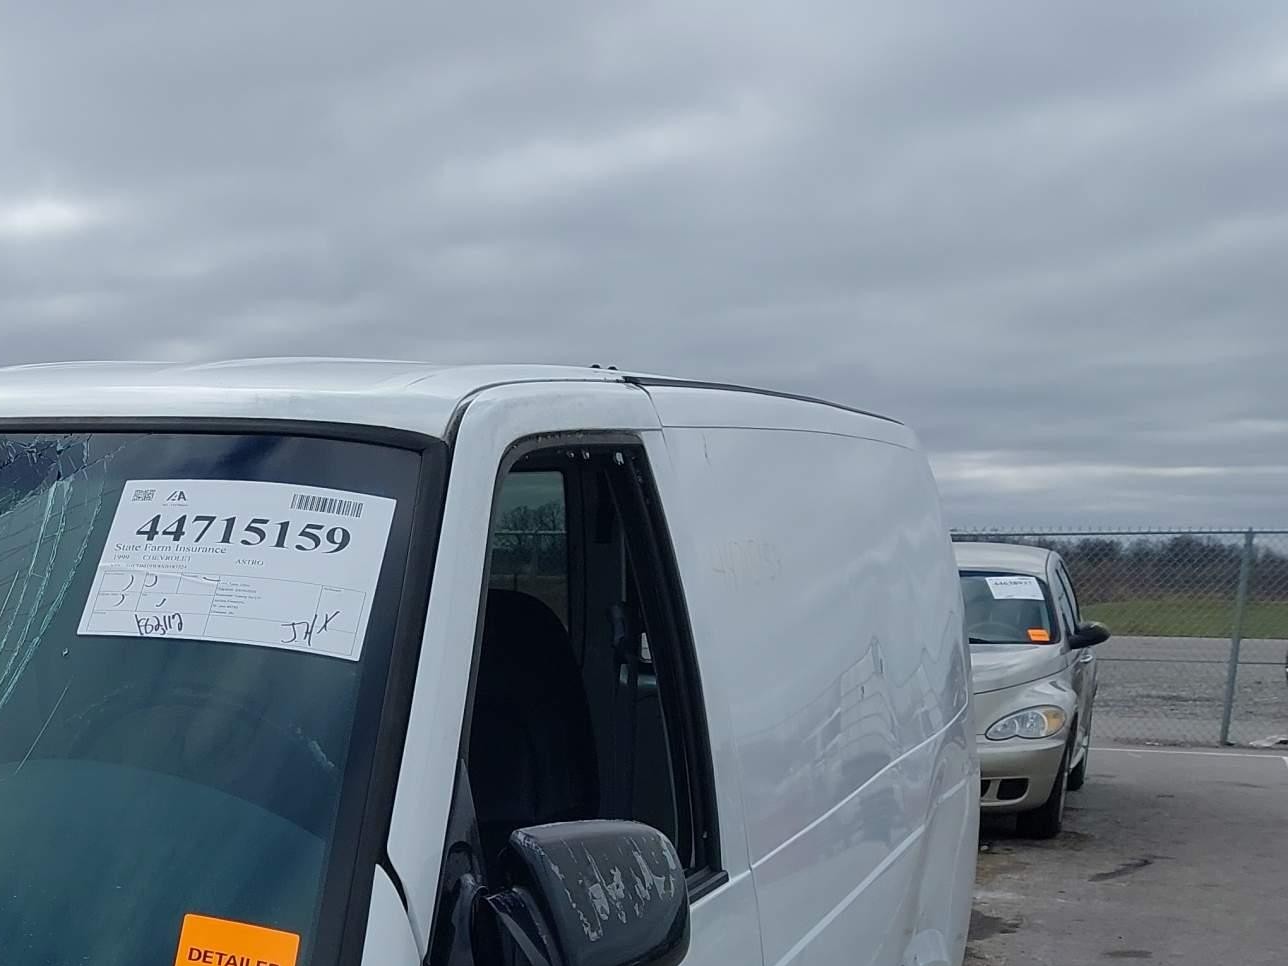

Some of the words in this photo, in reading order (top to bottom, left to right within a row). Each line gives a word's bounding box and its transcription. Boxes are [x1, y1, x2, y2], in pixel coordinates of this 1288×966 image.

[135, 514, 351, 554] 44715159
[114, 543, 141, 552] State
[144, 543, 172, 552] Farm
[175, 544, 227, 554] Insurance
[234, 558, 265, 567] ASTRO
